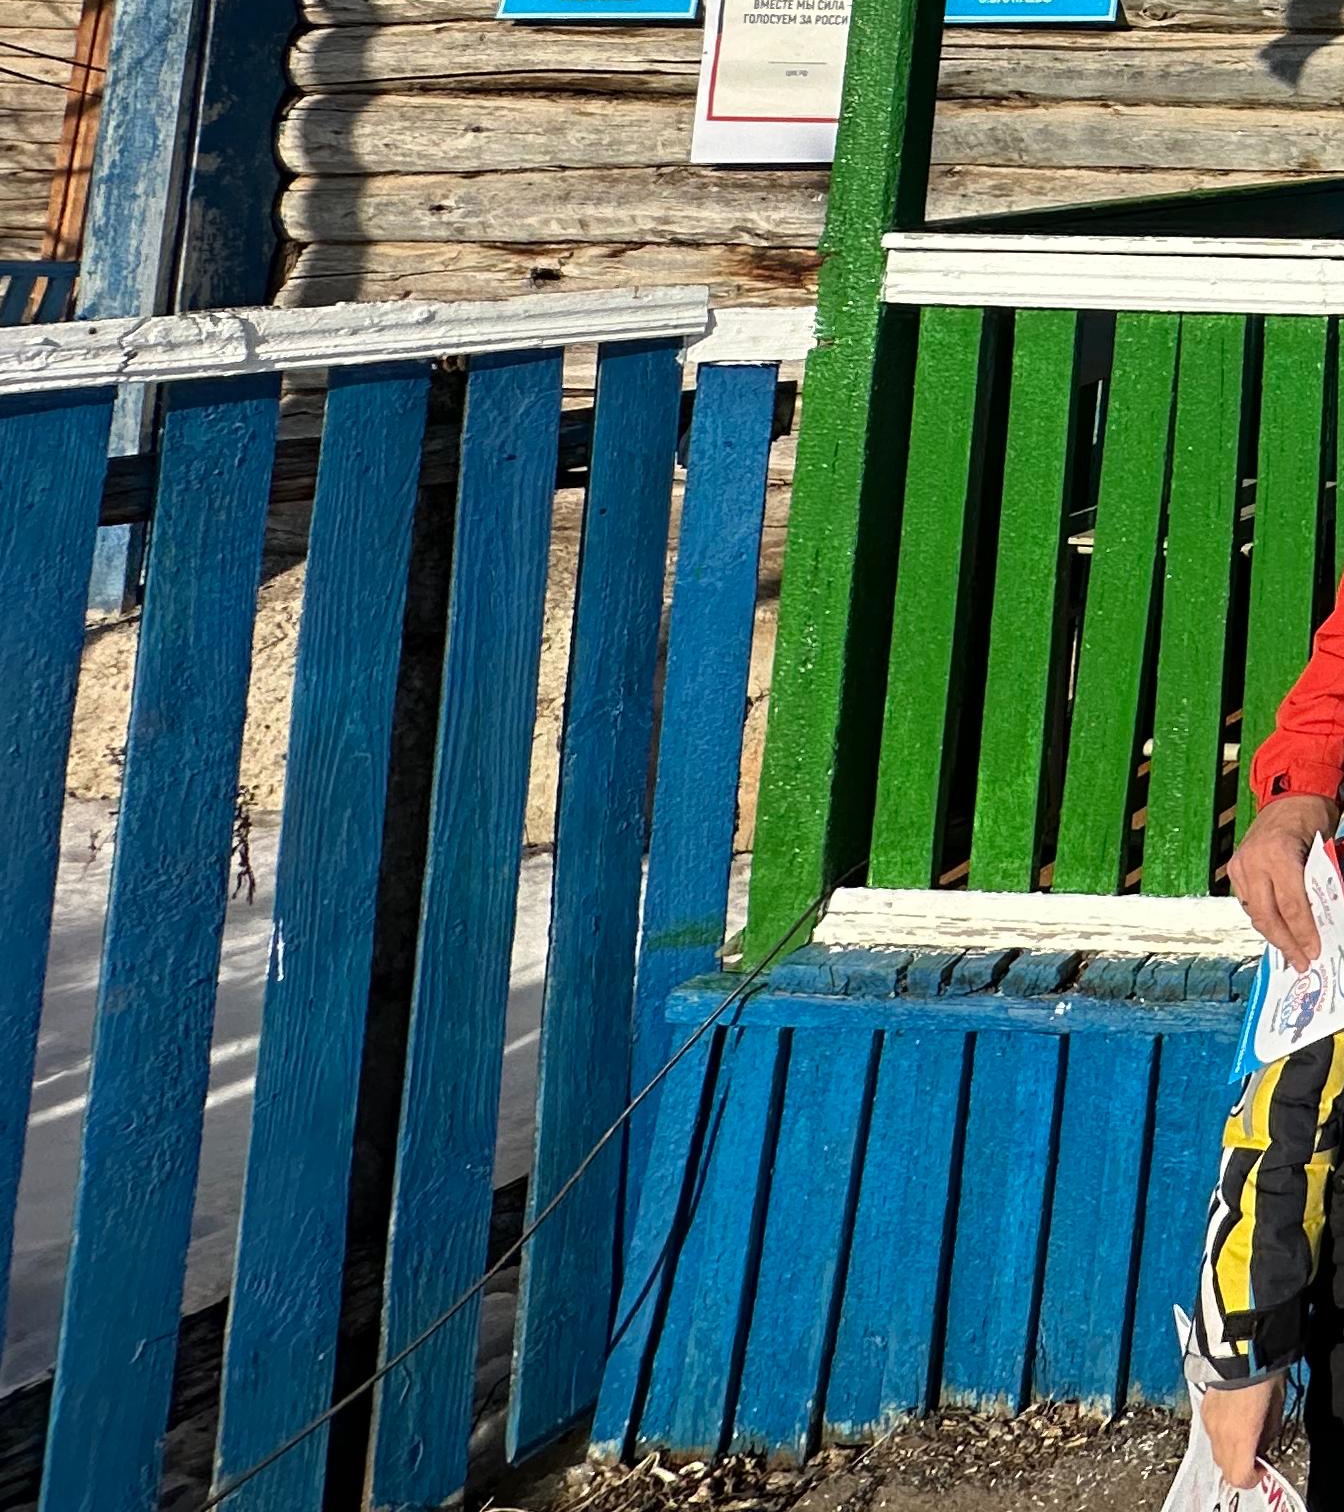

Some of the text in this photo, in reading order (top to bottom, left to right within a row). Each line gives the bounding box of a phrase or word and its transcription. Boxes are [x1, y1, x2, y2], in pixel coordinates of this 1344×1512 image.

[753, 0, 845, 11] ВМЕСТЕ МЫ СИЛА
[743, 14, 849, 25] ГОЛОСУЕМ ЗА РОССИ
